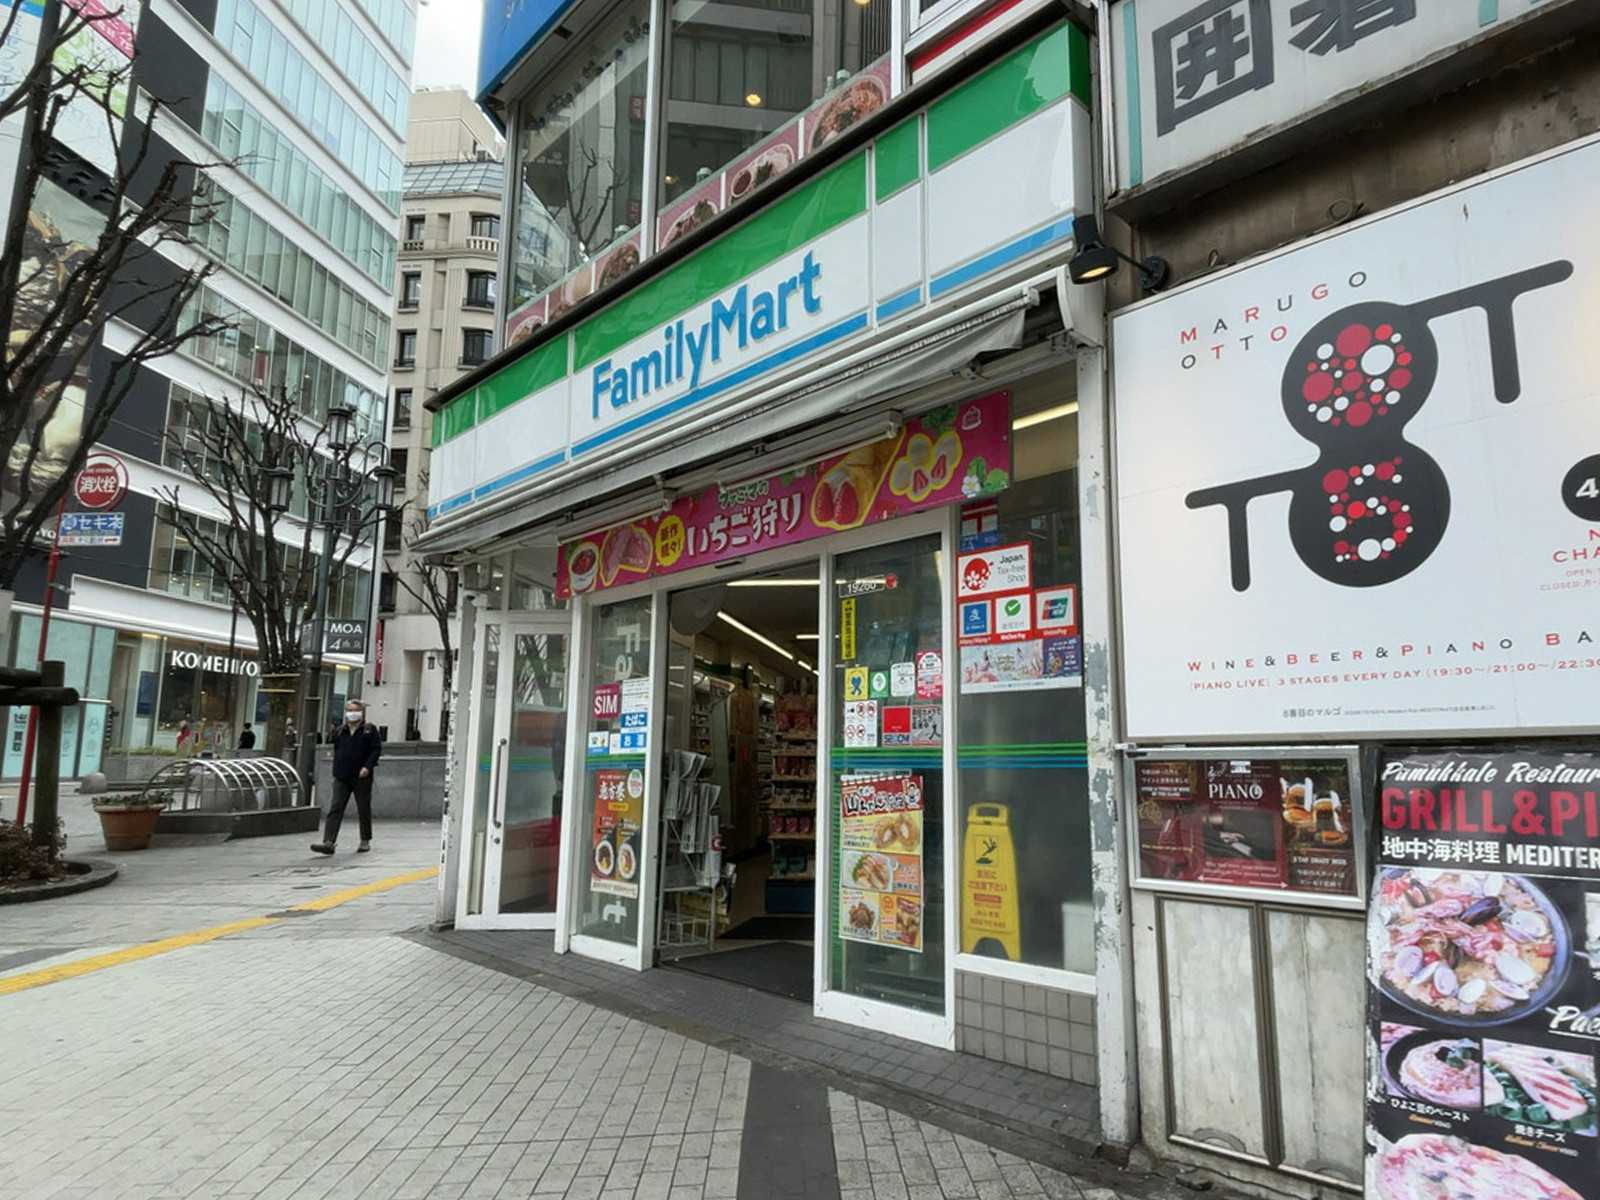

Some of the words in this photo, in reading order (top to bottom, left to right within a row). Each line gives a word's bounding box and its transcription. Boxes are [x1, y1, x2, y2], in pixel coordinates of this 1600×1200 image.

[1180, 271, 1367, 345] MARUGO
[590, 249, 824, 420] FamilyMart
[1181, 325, 1288, 370] OTTO
[80, 475, 117, 494] 消火栓
[686, 492, 803, 557] いちご狩り
[329, 622, 363, 634] MOA
[1277, 679, 1285, 687] 3
[1289, 675, 1339, 686] STAGES
[1343, 671, 1388, 682] EVERY
[1393, 669, 1421, 679] DAY
[593, 694, 618, 715] SIM
[1381, 761, 1498, 784] Pamukkale
[1208, 783, 1264, 800] PIANO
[1382, 835, 1500, 864] 地中海料理
